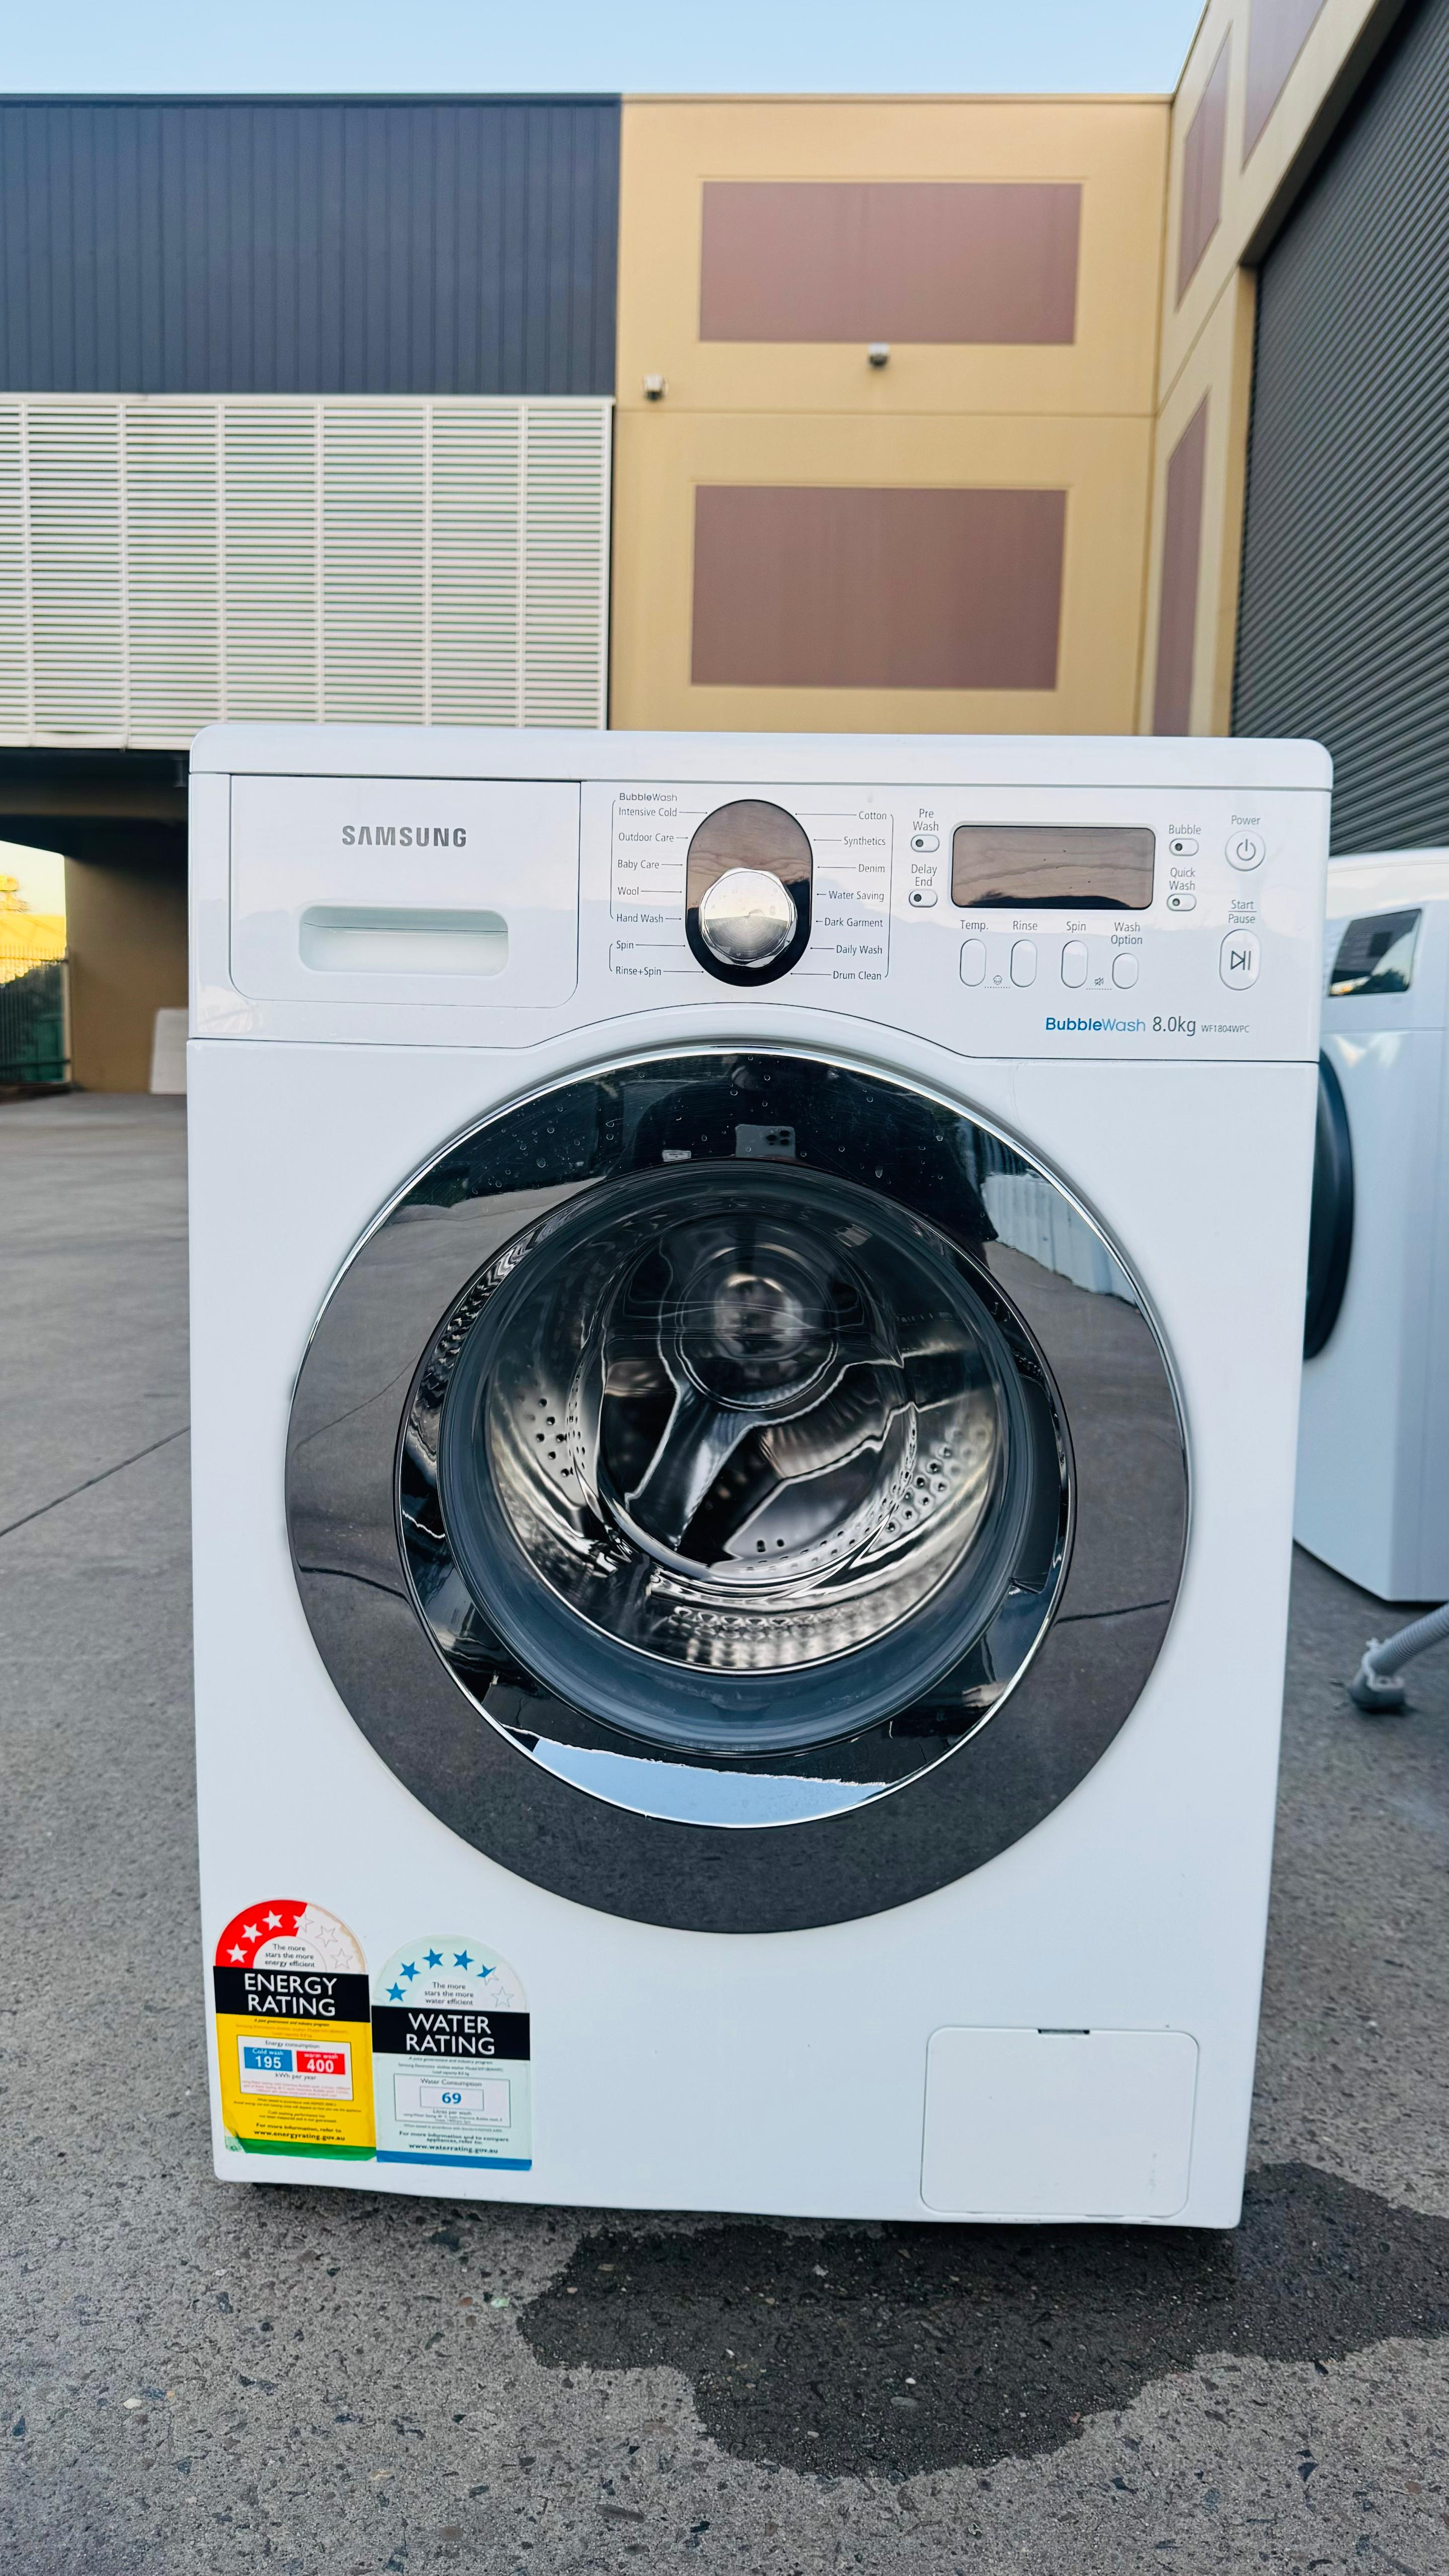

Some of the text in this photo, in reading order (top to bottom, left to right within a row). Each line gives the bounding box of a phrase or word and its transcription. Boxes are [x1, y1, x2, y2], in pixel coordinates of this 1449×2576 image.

[619, 792, 677, 801] BubbleWash
[619, 807, 677, 817] Intensive Cold
[858, 811, 887, 820] Cotton
[919, 808, 934, 818] Pre
[1231, 815, 1261, 825] Power
[913, 821, 939, 831] Wash
[1168, 824, 1201, 835] Bubble
[342, 825, 466, 848] SAMSUNG
[618, 832, 674, 842] Outdoor Care
[844, 836, 886, 848] Synthetics
[618, 859, 660, 871] Baby Care
[858, 863, 885, 873] Denim
[911, 863, 937, 877] Delay
[1170, 867, 1195, 879] Quick
[915, 876, 934, 887] End
[1169, 880, 1195, 891] Wash
[617, 887, 639, 896] Wool
[829, 890, 884, 903] Water Saving
[1231, 899, 1254, 910] Start
[616, 913, 663, 923] Hand Wash
[825, 917, 883, 927] Dark Garment
[1228, 913, 1256, 924] Pause
[960, 920, 989, 932] Temp.
[1013, 920, 1038, 931] Rinse
[1066, 921, 1086, 933] Spin
[1114, 922, 1141, 932] Wash
[616, 940, 634, 951] Spin
[1110, 934, 1143, 947] Option
[836, 944, 882, 956] Daily Wash
[616, 966, 661, 978] Rinse+Spin
[833, 971, 881, 980] Drum Clean
[1045, 1015, 1250, 1037] BubbleWash 8.0kg WF1804WPC
[245, 1973, 338, 1995] ENERGY
[248, 1994, 335, 2017] RATING
[408, 2013, 492, 2034] WATER
[406, 2034, 495, 2055] RATING
[255, 2055, 281, 2069] 195
[306, 2059, 334, 2073] 400
[441, 2091, 462, 2105] 69
[254, 2131, 345, 2141] www.energyrating.gov.au
[409, 2144, 498, 2154] www.waterrating.gov.au
